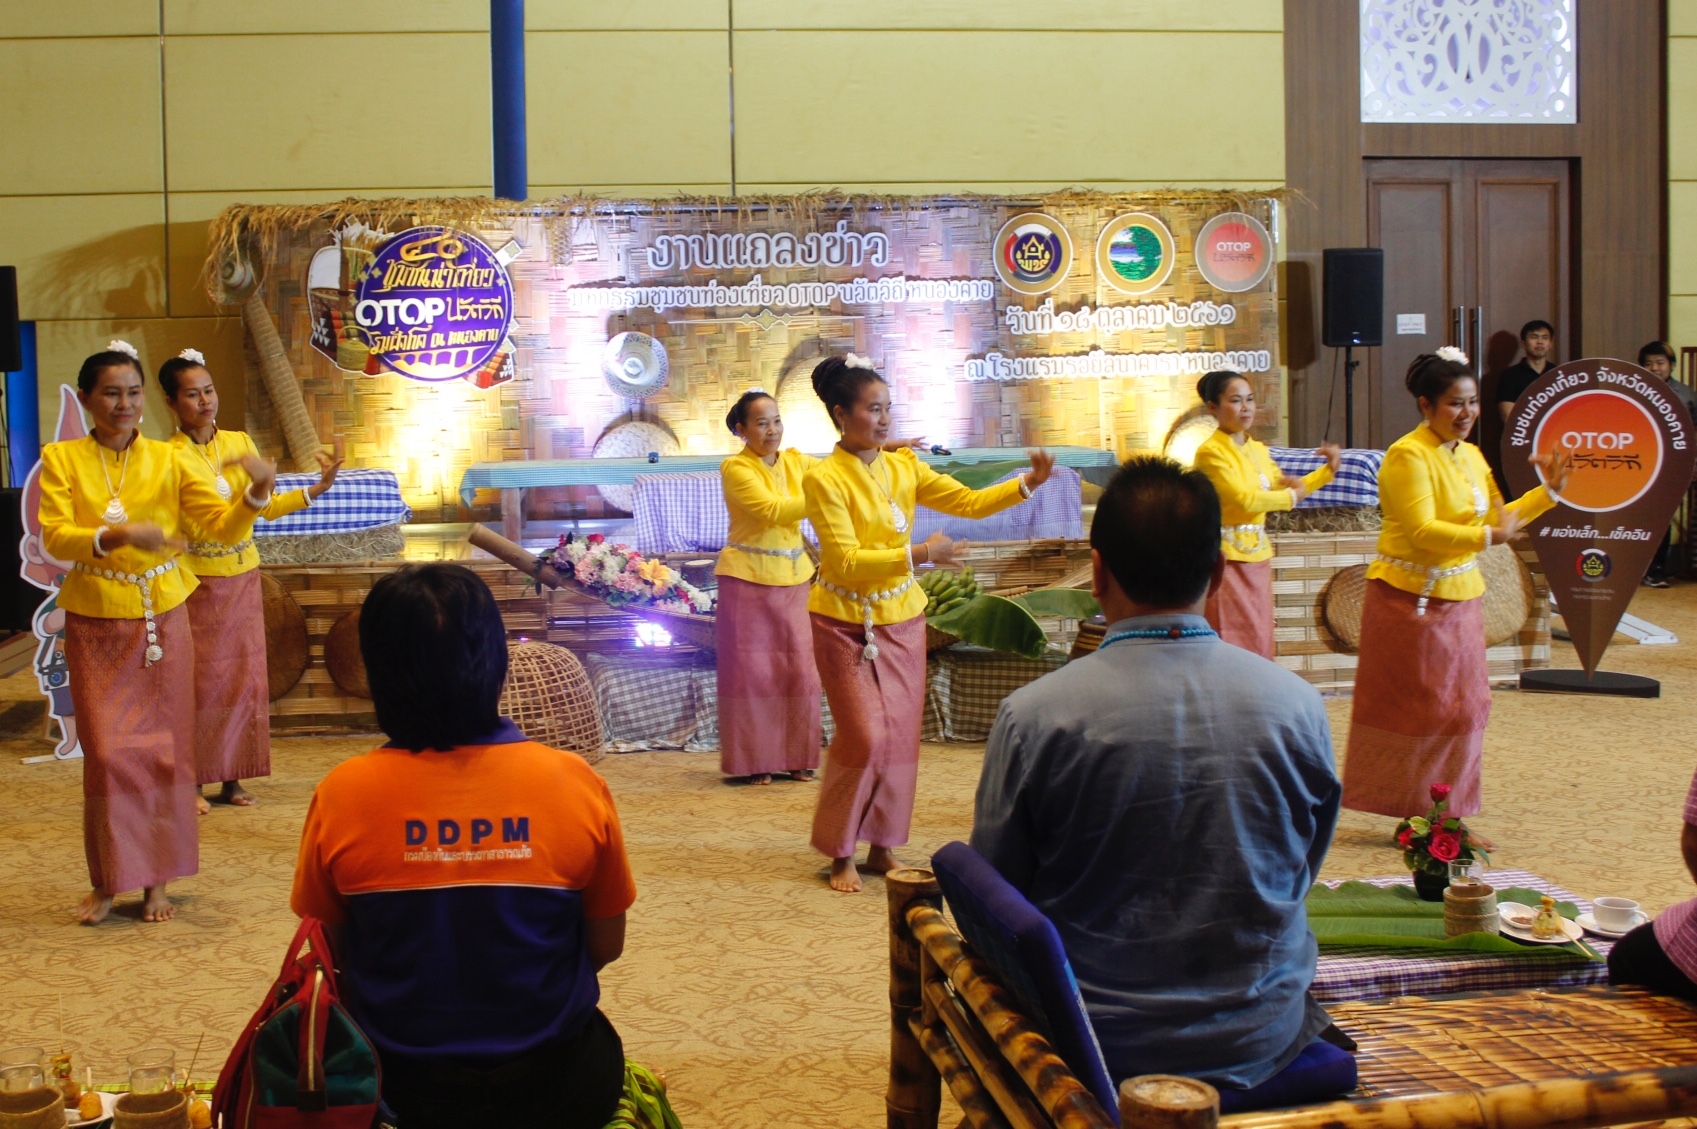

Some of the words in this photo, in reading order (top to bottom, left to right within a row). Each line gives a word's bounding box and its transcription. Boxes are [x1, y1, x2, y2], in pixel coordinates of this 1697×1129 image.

[647, 220, 889, 269] งานแถลงข่าว
[1216, 241, 1252, 252] OTOP
[787, 283, 837, 306] OTOP
[838, 277, 905, 304] นวัตวิถี
[907, 281, 994, 304] หนองคาย
[355, 297, 446, 327] OTOP
[446, 296, 504, 322] นวัตวิถี
[1006, 298, 1053, 334] วันที่
[1095, 305, 1166, 334] ตุลาคม
[1170, 300, 1237, 327] ๒๕๖๑
[447, 328, 500, 346] หนองคาย
[967, 358, 986, 381] ณ
[1511, 370, 1589, 447] ชุมชนท่องเที่ยว
[1596, 366, 1687, 450] จังหวัดหนองคาย
[1561, 431, 1634, 450] OTOP
[405, 817, 530, 846] DDPM
